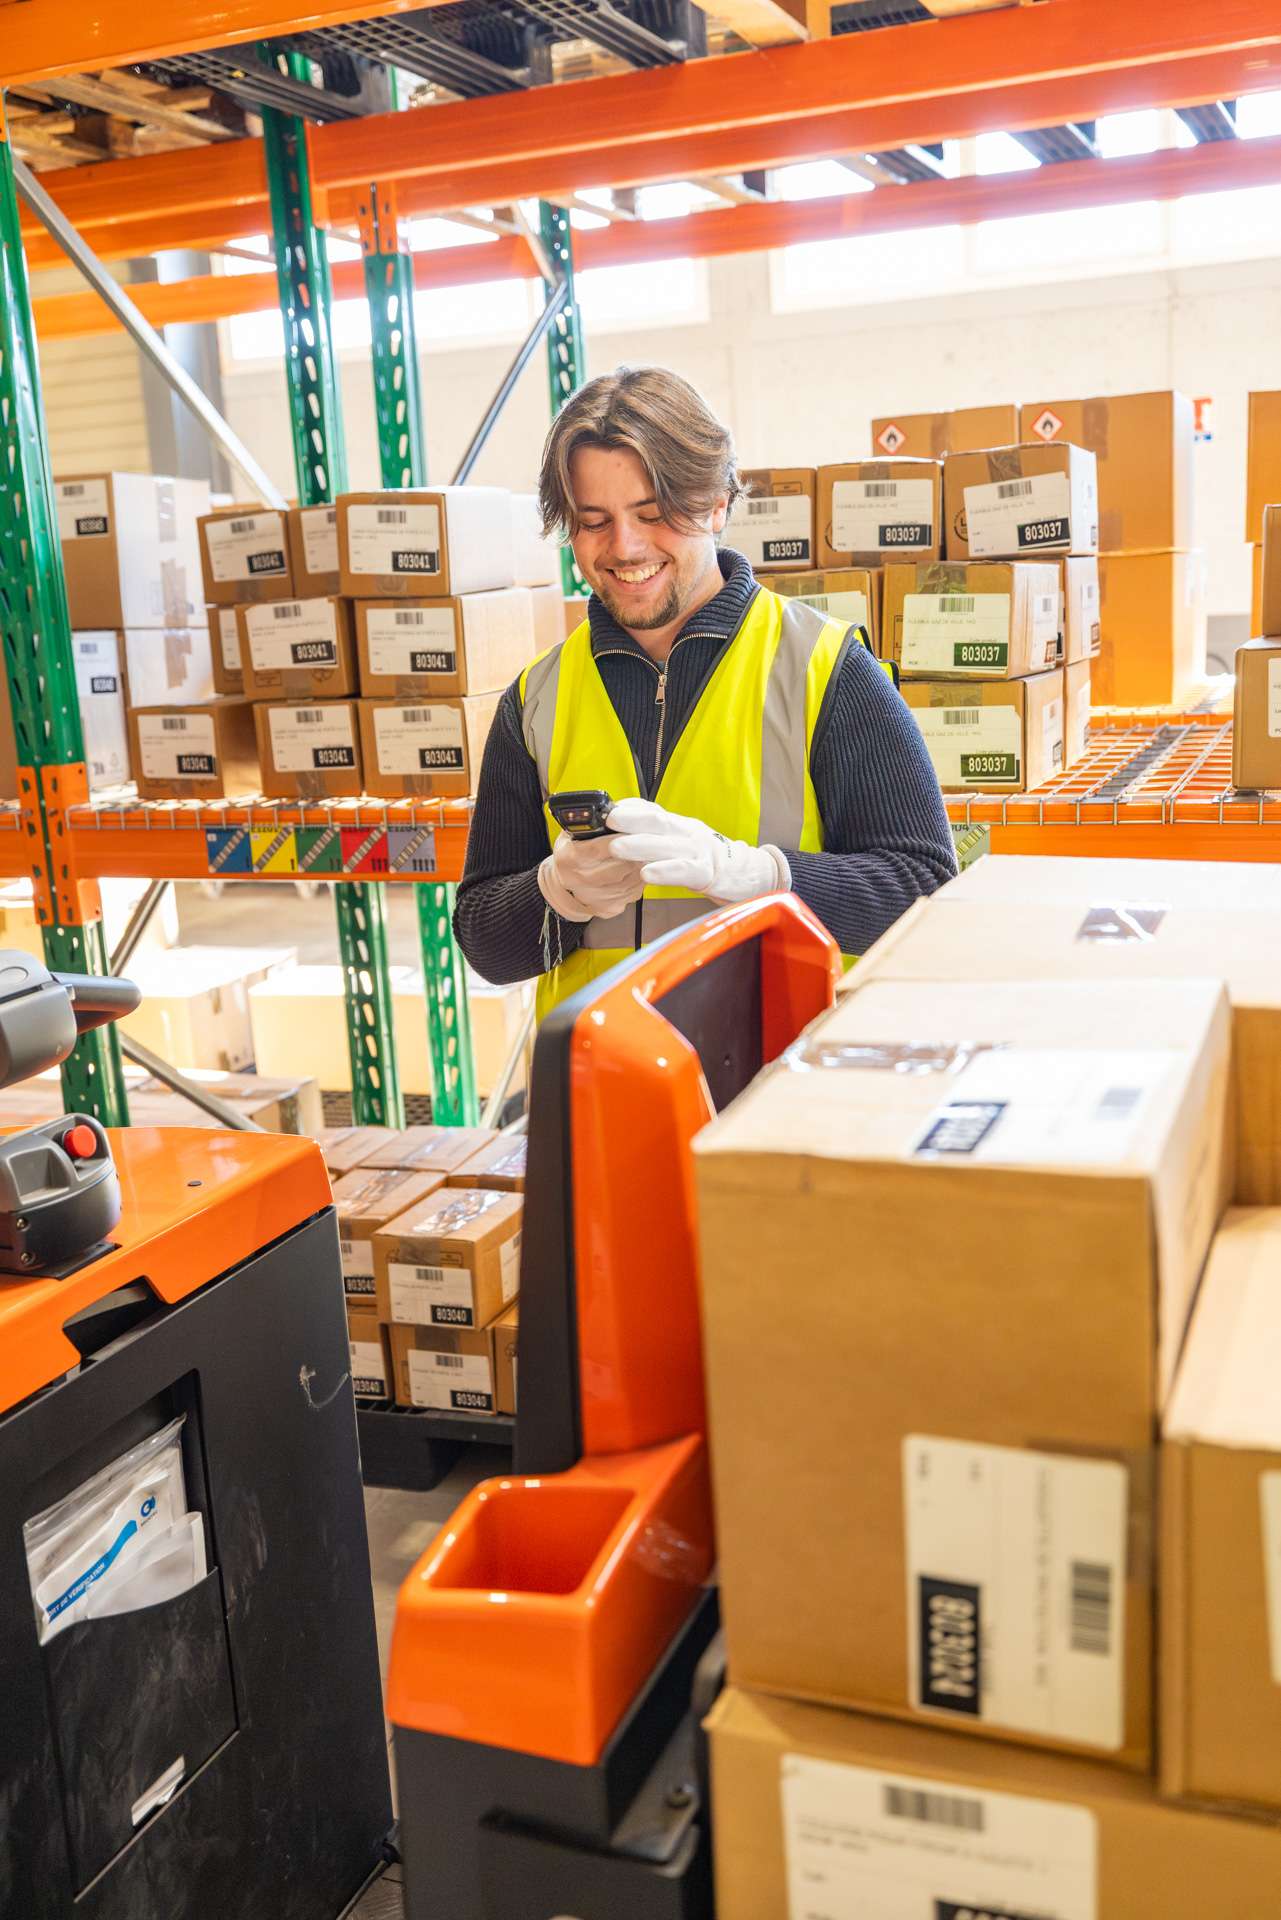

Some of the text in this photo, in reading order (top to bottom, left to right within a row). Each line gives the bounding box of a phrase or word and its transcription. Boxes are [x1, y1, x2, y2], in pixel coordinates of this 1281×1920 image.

[885, 527, 921, 542] 803037
[1024, 521, 1062, 541] 803037
[769, 542, 803, 557] 803037
[398, 553, 431, 569] 803041
[296, 643, 328, 659] 803041
[961, 646, 1000, 662] 803037
[415, 653, 448, 669] 803041
[181, 757, 209, 771] 803041
[318, 749, 349, 764] 803041
[425, 750, 457, 765] 803041
[968, 757, 1007, 772] 803037
[436, 1307, 467, 1322] 803040
[456, 1392, 487, 1407] 803040
